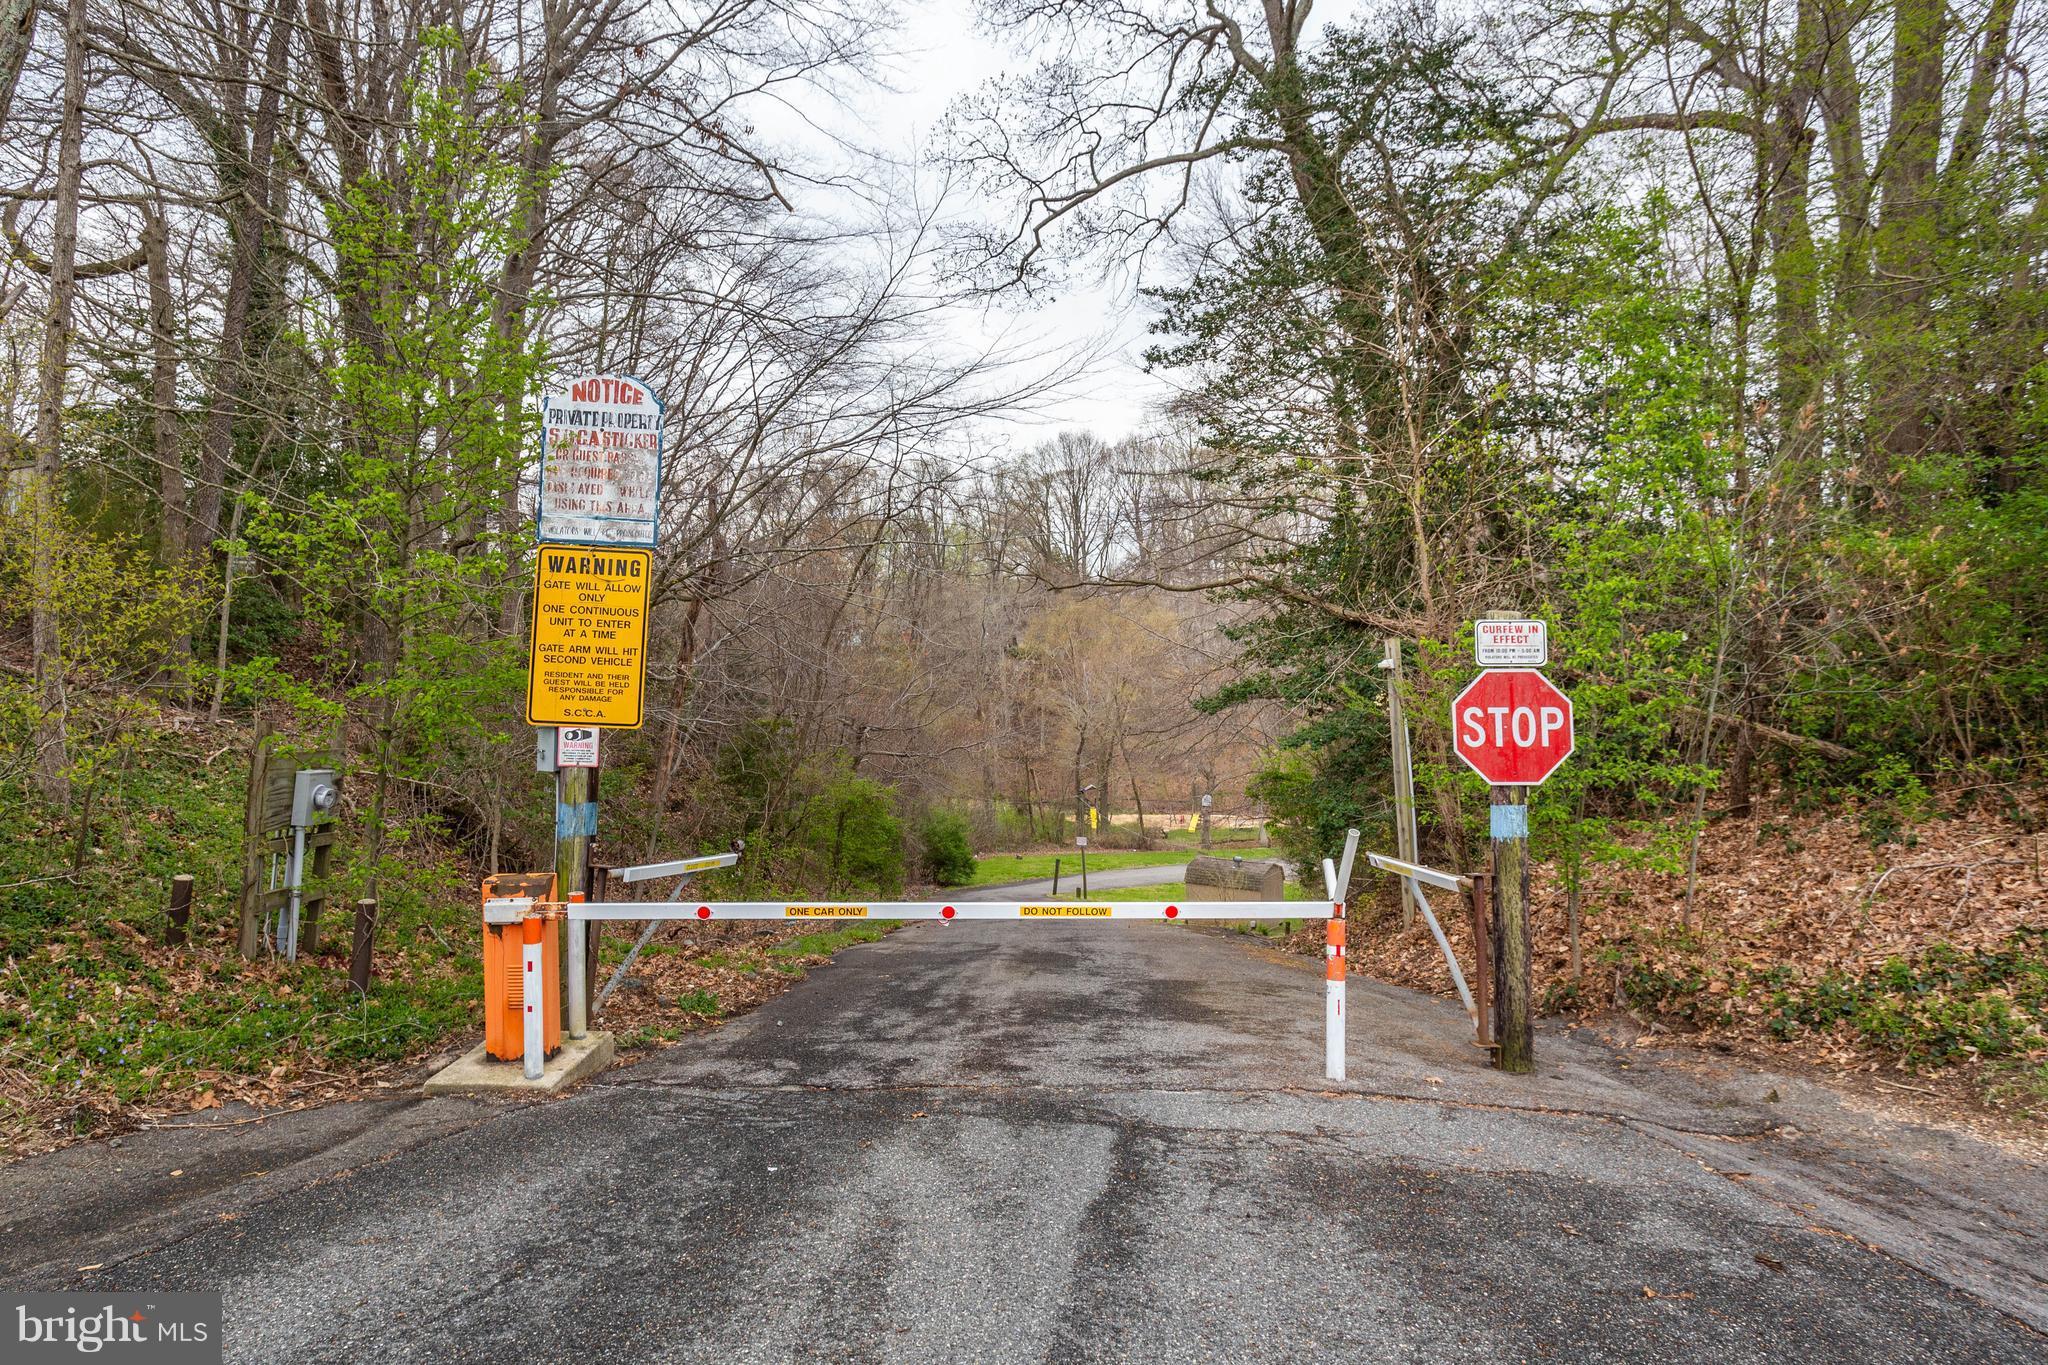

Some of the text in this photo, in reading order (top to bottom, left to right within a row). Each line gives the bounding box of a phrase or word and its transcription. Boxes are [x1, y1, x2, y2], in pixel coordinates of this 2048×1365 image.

[572, 378, 644, 405] NOTICE
[548, 408, 600, 427] PRIVATE
[555, 498, 586, 511] USING
[548, 555, 640, 578] WARNING
[544, 580, 642, 593] GATE WILL ALLOW
[578, 593, 606, 602] ONLY
[543, 604, 639, 617] ONE CONTINUOUS
[550, 617, 631, 629] UNIT TO ENTER
[563, 629, 616, 639] AT A TIME
[1482, 625, 1538, 634] CURFEW IN
[1493, 635, 1529, 643] EFFECT
[539, 644, 638, 656] GATE ARM WILL HIT
[544, 655, 632, 666] SECOND VEHICLE
[549, 686, 604, 695] RESPONSIBLE
[564, 709, 606, 718] S.C.C.A.
[1463, 706, 1565, 748] STOP
[789, 908, 863, 916] ONE CAR ONLY
[1024, 907, 1107, 916] DO NOT FOLLOW
